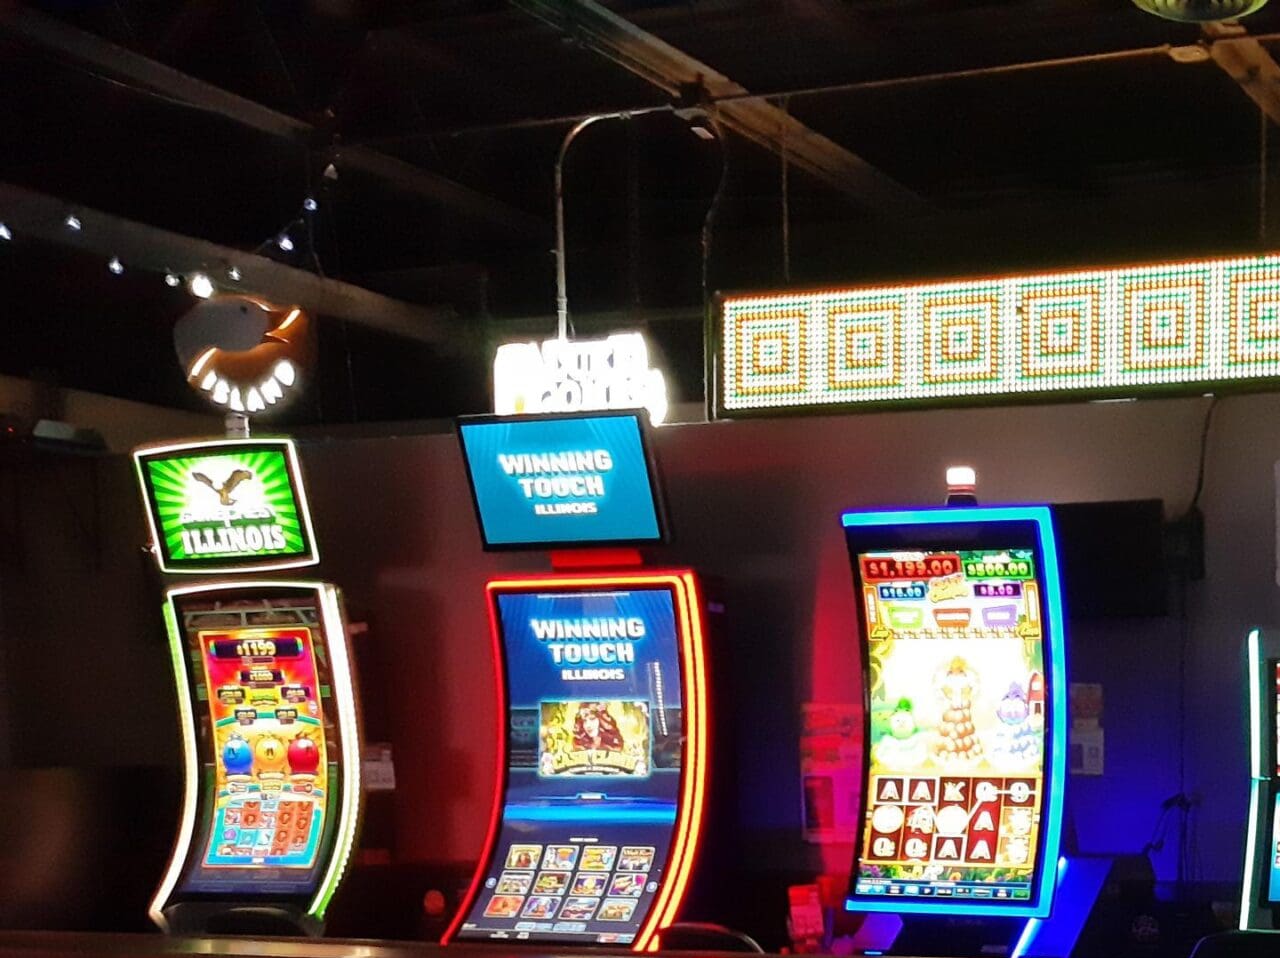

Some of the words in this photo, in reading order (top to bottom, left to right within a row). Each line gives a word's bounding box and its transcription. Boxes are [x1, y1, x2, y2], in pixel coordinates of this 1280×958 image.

[498, 449, 613, 475] WINNING
[518, 475, 605, 499] TOUCH
[534, 502, 598, 515] ILLINOIS
[182, 525, 287, 555] ILLINOIS
[529, 617, 647, 641] WINNING
[547, 642, 635, 664] TOUCH
[561, 668, 625, 681] ILLINOIS
